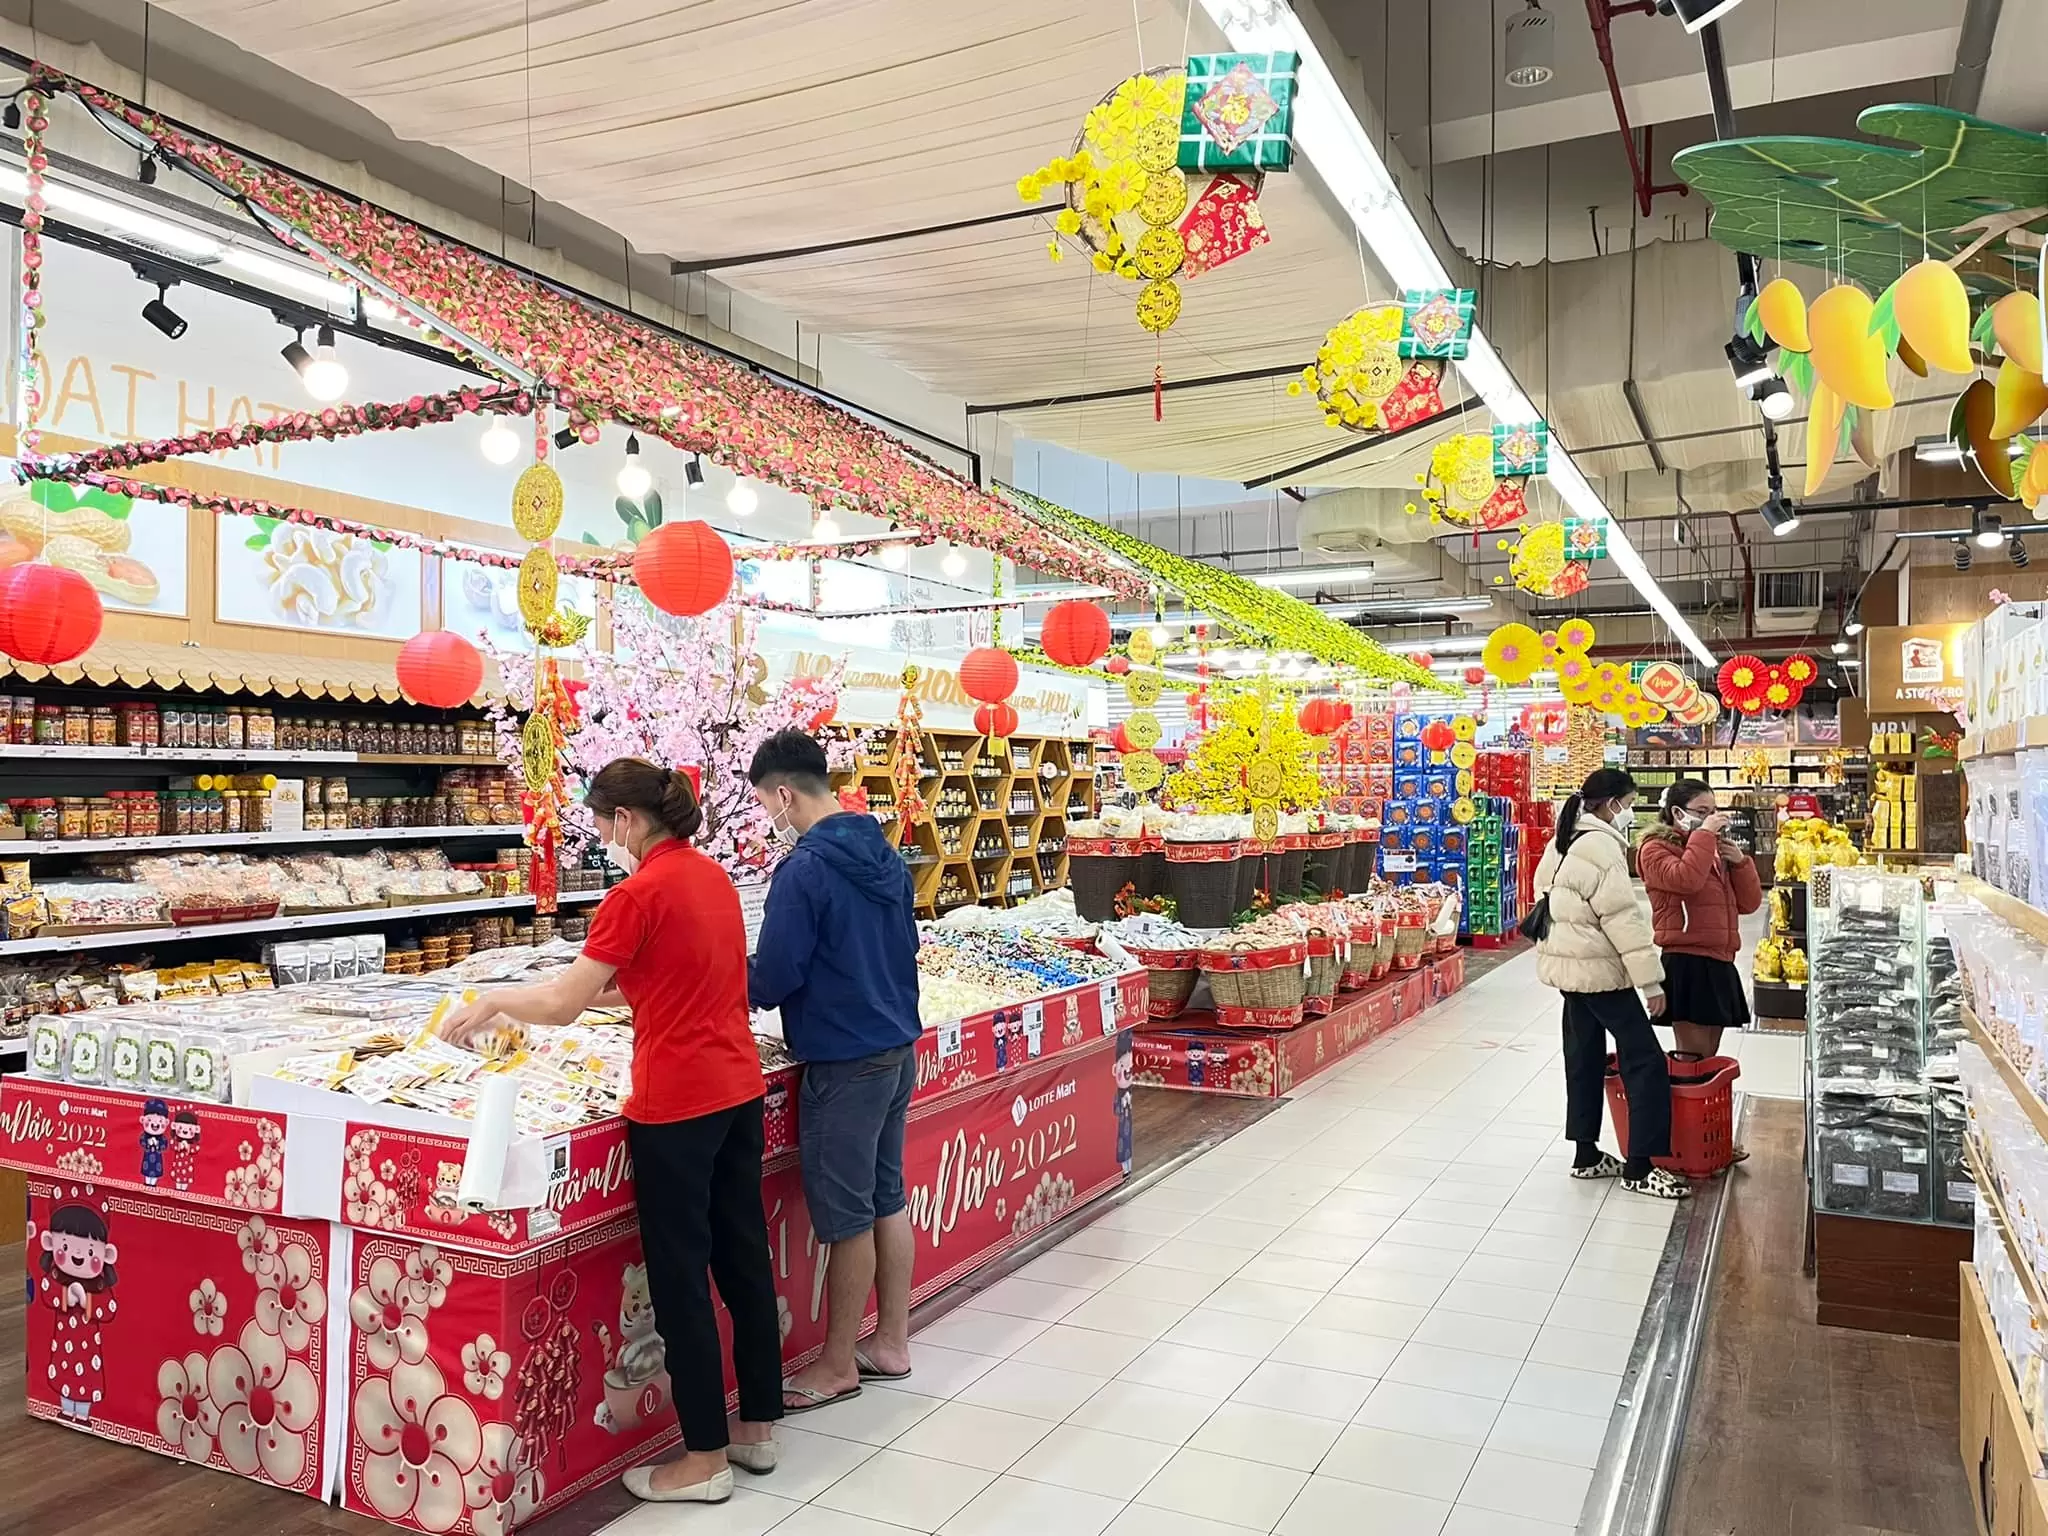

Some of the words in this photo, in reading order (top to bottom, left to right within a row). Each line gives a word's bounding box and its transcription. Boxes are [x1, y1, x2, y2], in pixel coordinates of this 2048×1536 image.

[1028, 1092, 1056, 1112] LOTTE
[1055, 1079, 1076, 1101] Mart
[70, 1106, 90, 1116] LOTTE
[90, 1107, 108, 1119] Mart
[56, 1120, 107, 1148] 2022
[1009, 1113, 1078, 1182] 2022
